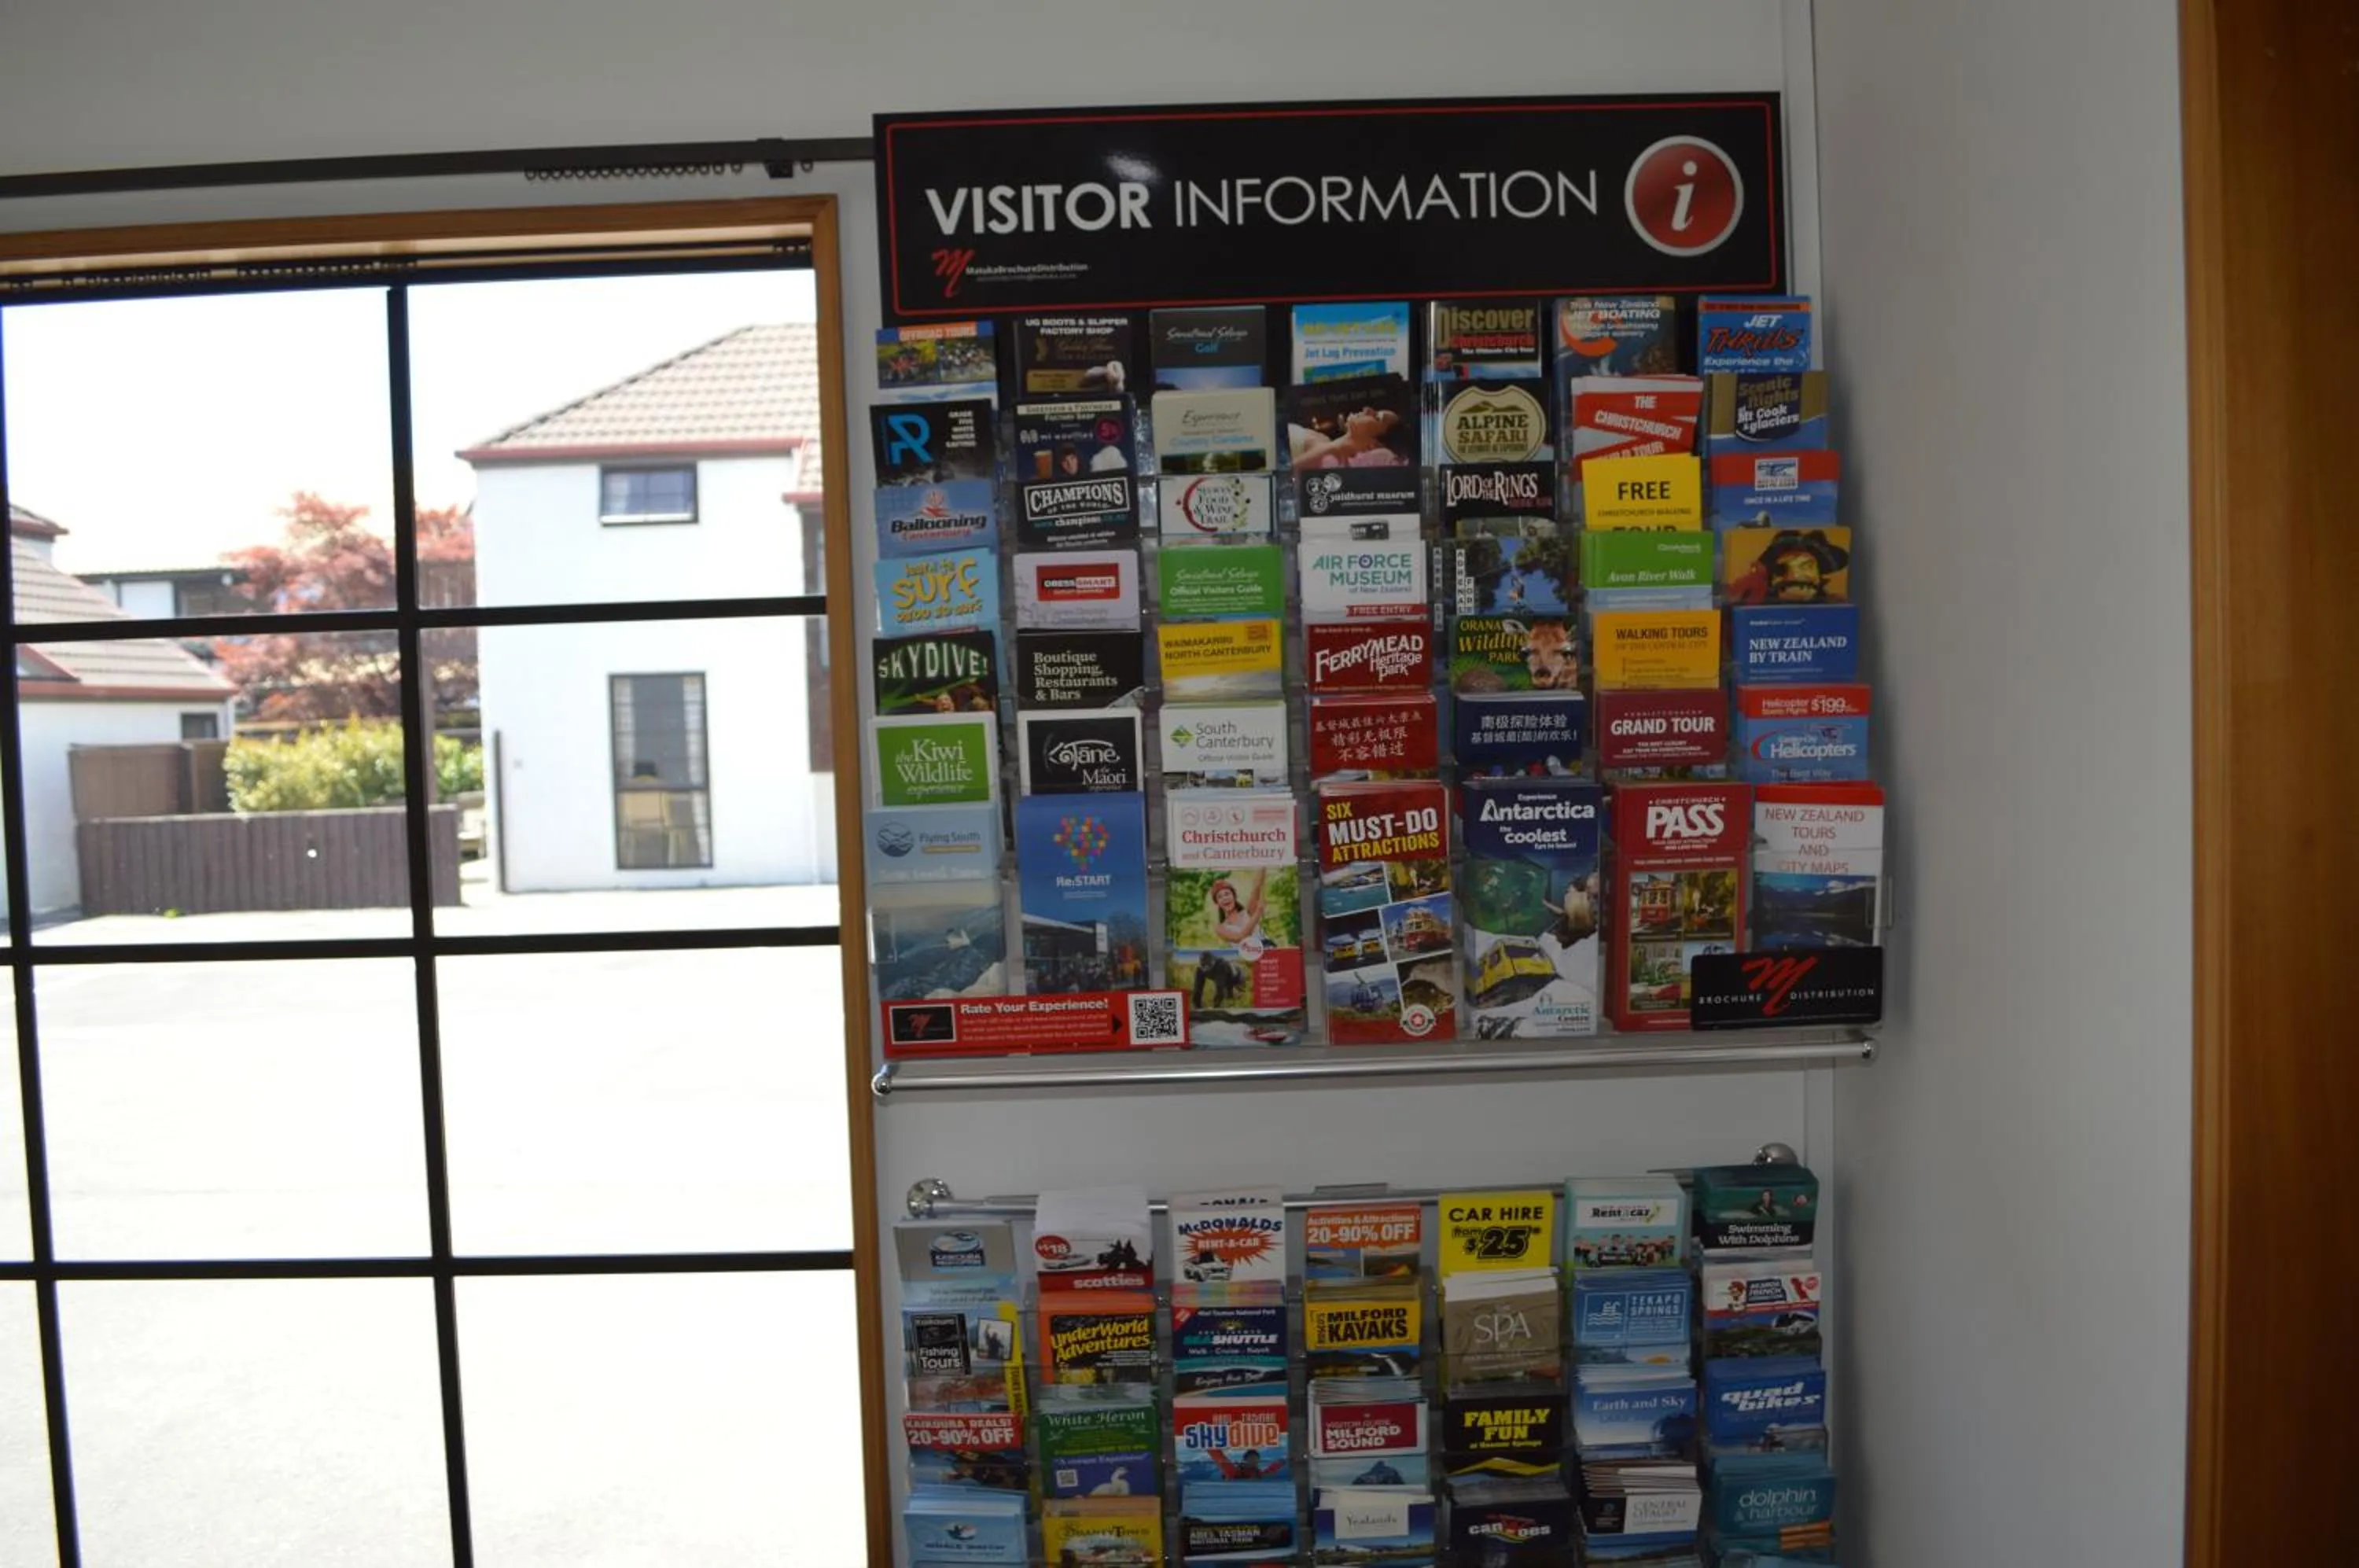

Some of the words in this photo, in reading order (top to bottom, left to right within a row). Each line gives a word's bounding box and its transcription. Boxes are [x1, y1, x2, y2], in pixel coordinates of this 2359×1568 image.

[926, 182, 1153, 236] VISITOR
[1176, 167, 1599, 227] INFORMATION
[1437, 307, 1535, 349] Discover
[1743, 314, 1783, 329] JET
[1704, 355, 1771, 367] Experience
[1634, 395, 1658, 410] THE
[1456, 414, 1529, 430] ALPINE
[1594, 409, 1684, 441] CHRISTCHURCH
[1457, 429, 1529, 444] SAFARI
[1445, 469, 1483, 507] LORD
[1493, 470, 1539, 505] RINGS
[1617, 480, 1672, 502] FREE
[1030, 482, 1124, 513] CHAMPIONS
[890, 514, 988, 534] Ballooning
[1312, 554, 1343, 571] AIR
[1347, 552, 1413, 569] FORCE
[1329, 569, 1412, 587] MUSEUM
[1637, 570, 1668, 583] River
[1459, 618, 1504, 632] ORANA
[1615, 628, 1669, 640] WALKING
[1672, 626, 1709, 639] TOURS
[1459, 631, 1529, 653] Wildlife
[1748, 637, 1782, 652] NEW
[1783, 635, 1849, 650] ZEALAND
[877, 640, 988, 679] SKYDIVE!
[1032, 651, 1098, 667] Boutique
[1164, 649, 1201, 663] NORTH
[1202, 643, 1272, 661] CANTERBURY
[1315, 634, 1425, 683] FERRYMEAD
[1488, 652, 1522, 664] PARK
[1748, 650, 1768, 664] BY
[1769, 650, 1813, 664] TRAIN
[1369, 652, 1423, 673] Heritage
[1035, 675, 1118, 689] Restaurants
[1034, 687, 1047, 701] &
[1050, 686, 1081, 701] Bars
[1195, 720, 1238, 736] South
[1610, 717, 1667, 736] GRAND
[1671, 716, 1716, 734] TOUR
[911, 738, 967, 763] Kiwi
[1195, 734, 1275, 751] Canterbury
[1769, 742, 1860, 762] Helicopters
[895, 760, 974, 785] Wildlife
[1326, 801, 1354, 822] SIX
[1478, 797, 1596, 823] Antarctica
[1764, 808, 1798, 822] NEW
[1799, 808, 1865, 823] ZEALAND
[1327, 807, 1439, 846] MUST-DO
[1645, 802, 1725, 840] PASS
[1181, 827, 1287, 845] Christchurch
[1503, 827, 1568, 845] coolest
[1790, 826, 1837, 841] TOURS
[1201, 845, 1286, 863] Canterbury
[1331, 830, 1441, 864] ATTRACTIONS
[1798, 845, 1830, 857] AND
[1776, 861, 1809, 874] CITY
[959, 1003, 993, 1015] Rate
[996, 1001, 1027, 1014] Your
[1028, 997, 1110, 1013] Experience!
[1698, 992, 1763, 1007] BROCHURE
[1789, 987, 1876, 1002] DISTRIBUTION
[1448, 1206, 1493, 1223] CAR
[1499, 1205, 1544, 1221] HIRE
[1592, 1207, 1622, 1218] Rent
[1630, 1208, 1651, 1217] car
[1177, 1216, 1283, 1235] McDONALDS
[1307, 1224, 1379, 1244] 20-90%
[1380, 1223, 1416, 1242] OFF
[1728, 1223, 1793, 1236] Swimming
[1197, 1236, 1262, 1250] RENT-A-CAR
[1718, 1235, 1748, 1246] With
[1748, 1233, 1801, 1246] Dolphins
[1073, 1272, 1146, 1290] scotties
[1631, 1293, 1682, 1306] TEKAPO
[1327, 1308, 1408, 1323] MILFORD
[1629, 1305, 1680, 1317] SPRINGS
[1051, 1319, 1150, 1350] UnderWorld
[1328, 1320, 1408, 1343] KAYAKS
[1473, 1310, 1533, 1344] SPA
[1056, 1334, 1152, 1363] Adventures
[1211, 1334, 1279, 1345] SHUTTLE
[919, 1346, 959, 1360] Fishing
[919, 1356, 962, 1370] Tours
[1720, 1381, 1805, 1405] quad
[1592, 1397, 1629, 1411] Earth
[1631, 1396, 1658, 1409] and
[1660, 1395, 1687, 1410] Sky
[1735, 1393, 1822, 1412] bikes
[1047, 1413, 1091, 1427] White
[1096, 1410, 1146, 1425] Heron
[1463, 1408, 1551, 1429] FAMILY
[907, 1428, 981, 1445] 20-90%
[981, 1427, 1014, 1445] OFF
[1184, 1422, 1279, 1449] skydive
[1325, 1425, 1402, 1440] MILFORD
[1483, 1425, 1529, 1441] FUN
[1325, 1436, 1386, 1450] SOUND
[1739, 1485, 1818, 1509] dolphin
